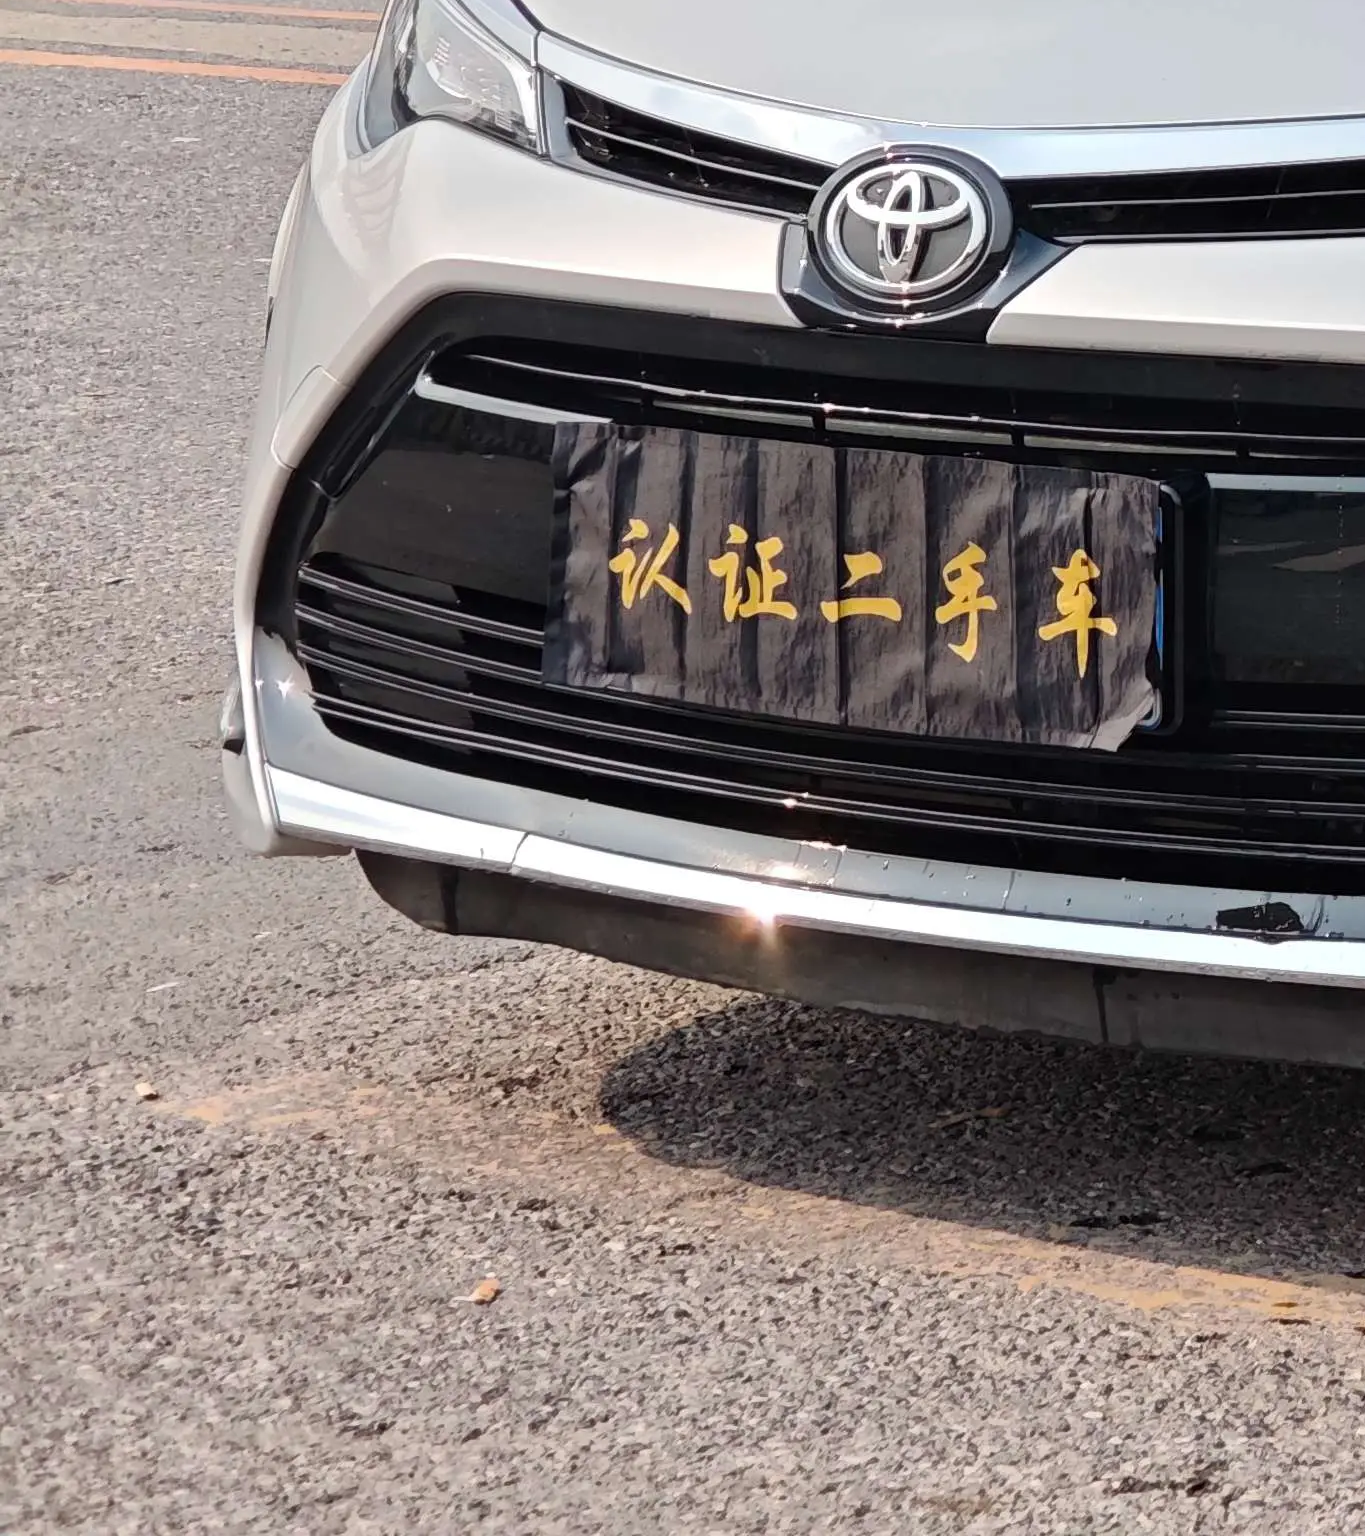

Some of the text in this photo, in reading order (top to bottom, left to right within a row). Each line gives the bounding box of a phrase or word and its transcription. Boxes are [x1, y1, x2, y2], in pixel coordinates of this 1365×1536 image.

[608, 516, 1118, 679] 认证二手车
